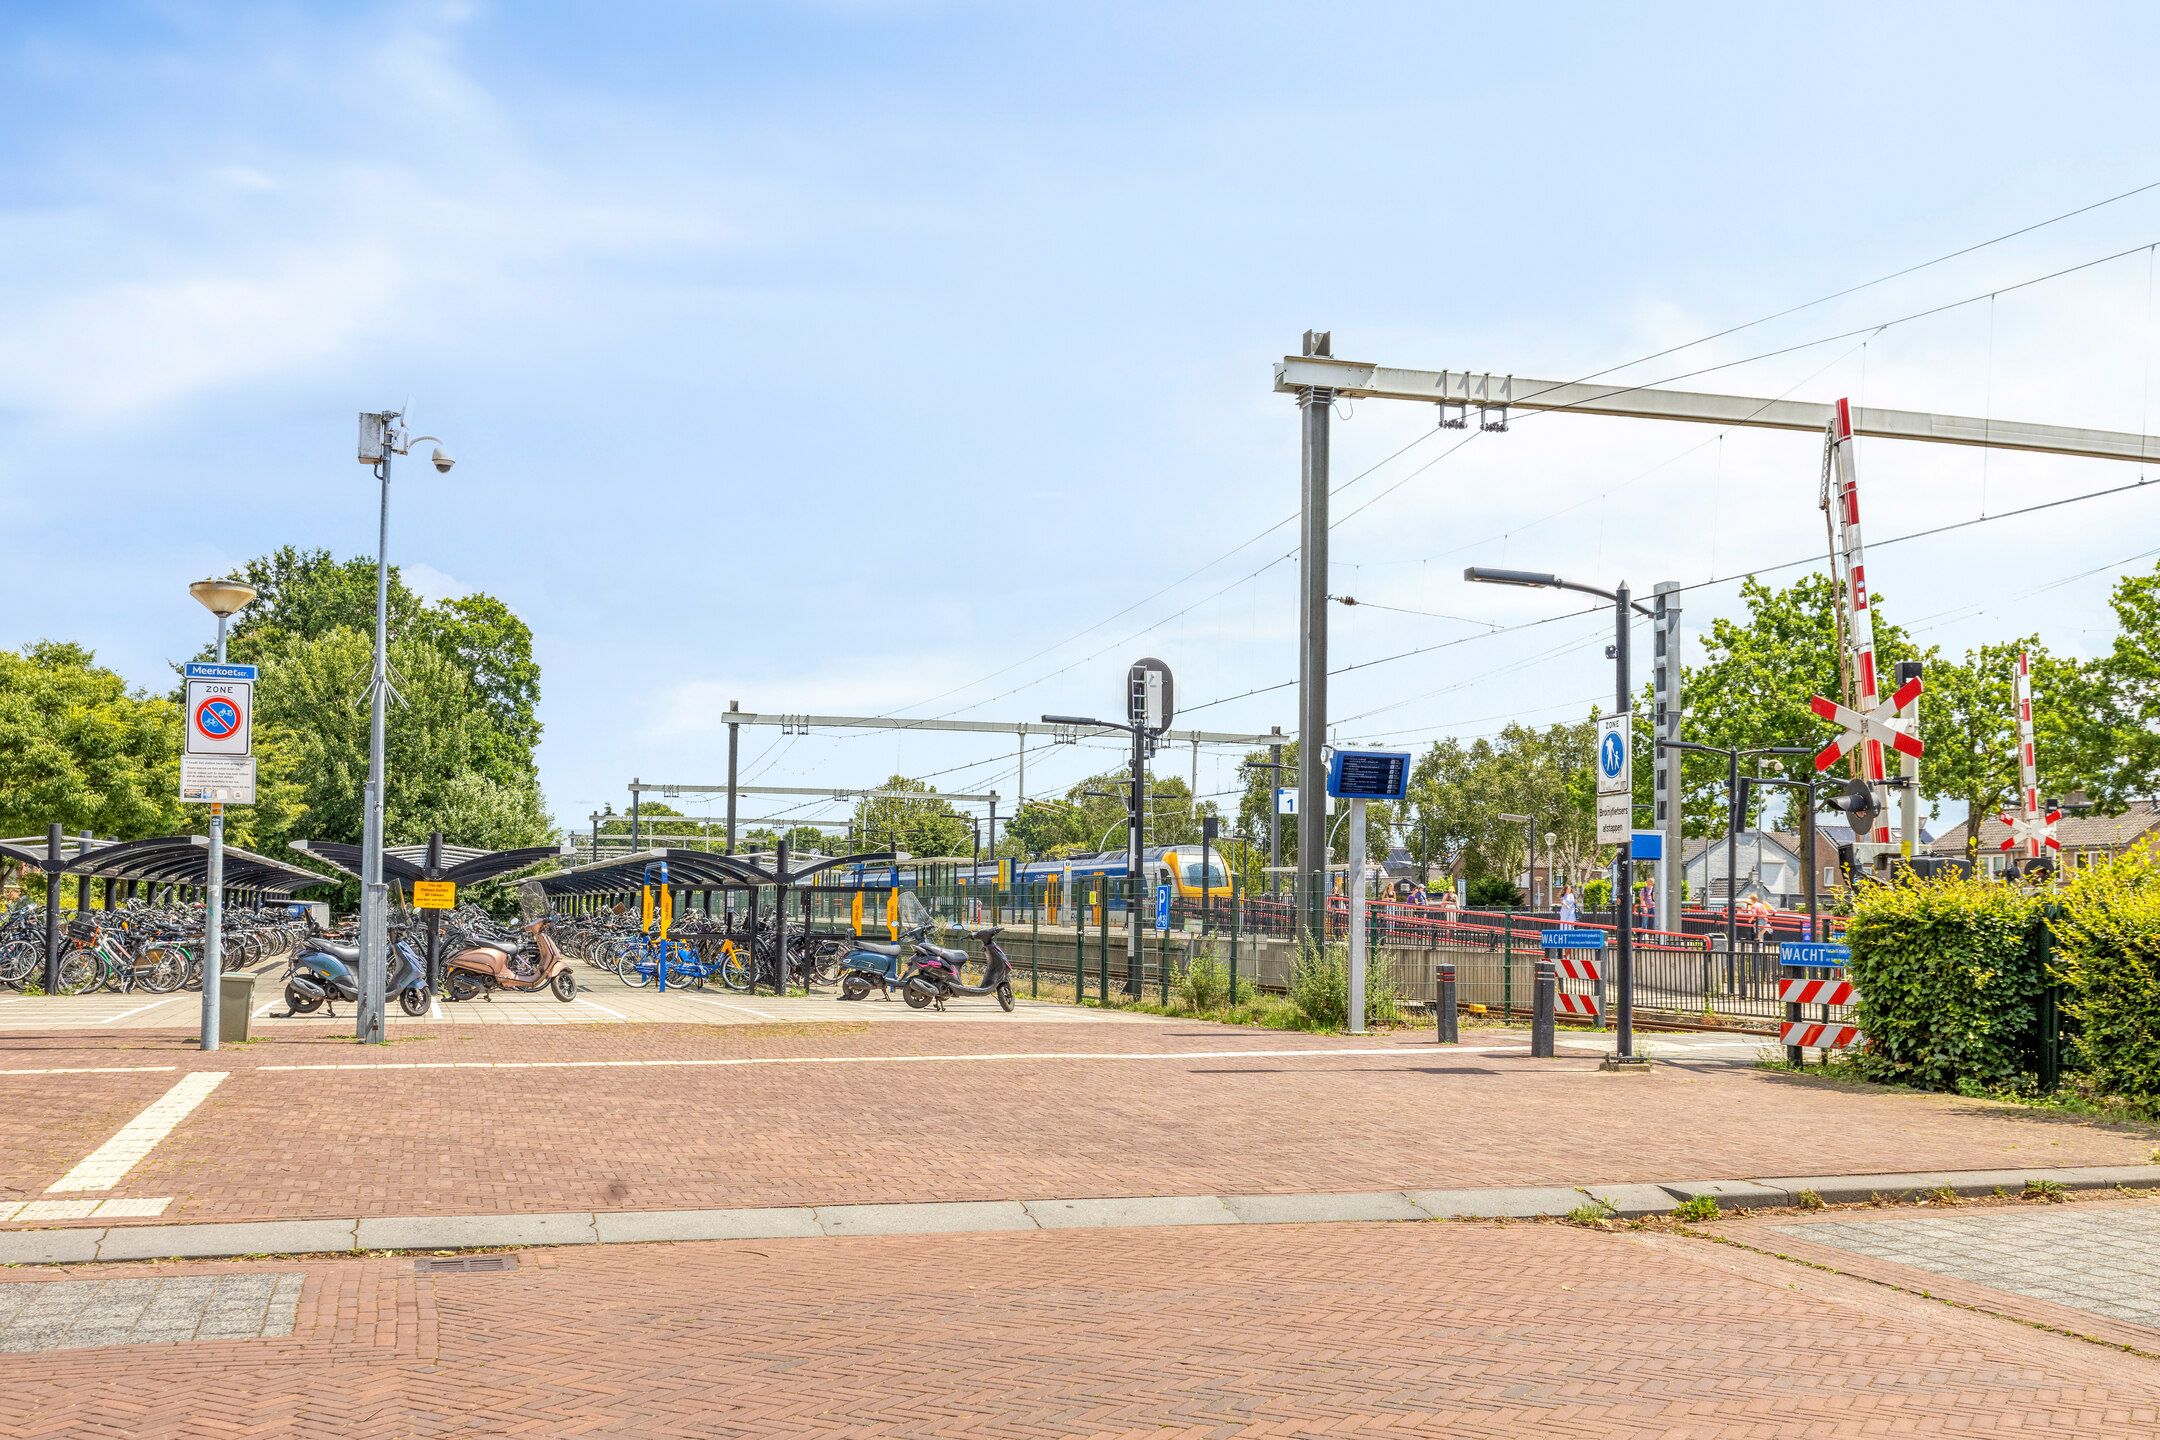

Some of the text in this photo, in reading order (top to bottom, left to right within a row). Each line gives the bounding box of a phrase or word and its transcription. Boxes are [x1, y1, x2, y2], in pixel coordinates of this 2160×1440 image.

[205, 685, 234, 694] ZONE
[1605, 720, 1619, 729] ZONE
[1287, 798, 1293, 812] 1
[1602, 824, 1623, 833] afstappen
[1159, 889, 1166, 912] P
[1541, 933, 1568, 945] WACHT
[1781, 947, 1826, 962] WACHT
